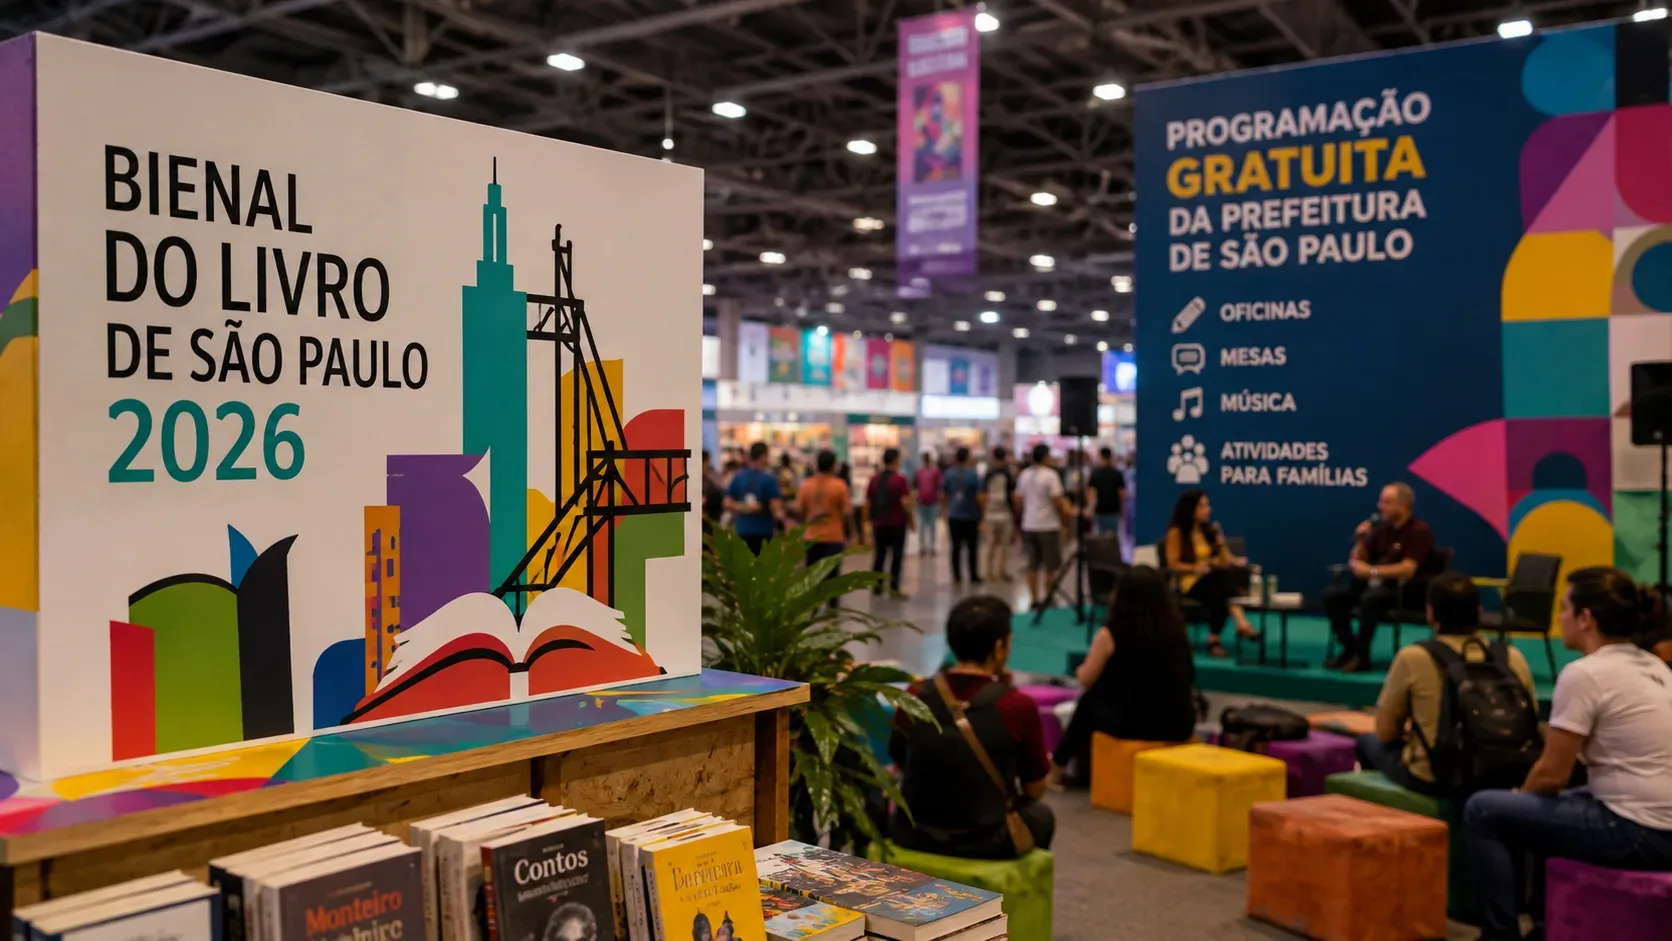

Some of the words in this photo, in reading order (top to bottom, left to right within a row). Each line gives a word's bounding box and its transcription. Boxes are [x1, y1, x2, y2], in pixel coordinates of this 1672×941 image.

[1166, 88, 1432, 151] PROGRAMAÇÃO
[105, 144, 313, 234] BIENAL
[1166, 135, 1428, 198] GRATUITA
[1169, 206, 1213, 236] DA
[1221, 189, 1427, 232] PREFEITURA
[1169, 242, 1211, 272] DE
[1219, 233, 1288, 270] SÃO
[1298, 228, 1414, 265] PAULO
[105, 229, 198, 307] DO
[221, 242, 390, 322] LIVRO
[1219, 300, 1311, 322] OFICINAS
[107, 323, 173, 380] DE
[190, 319, 283, 385] SÃO
[299, 335, 428, 389] PAULO
[1220, 346, 1287, 366] MESAS
[1220, 389, 1297, 412] MÚSICA
[108, 398, 305, 483] 2026
[1220, 442, 1329, 460] ATIVIDADES
[1220, 466, 1272, 484] PARA
[1277, 463, 1368, 487] FAMÍLIAS
[514, 849, 589, 885] Contos
[305, 888, 403, 938] Monteiro
